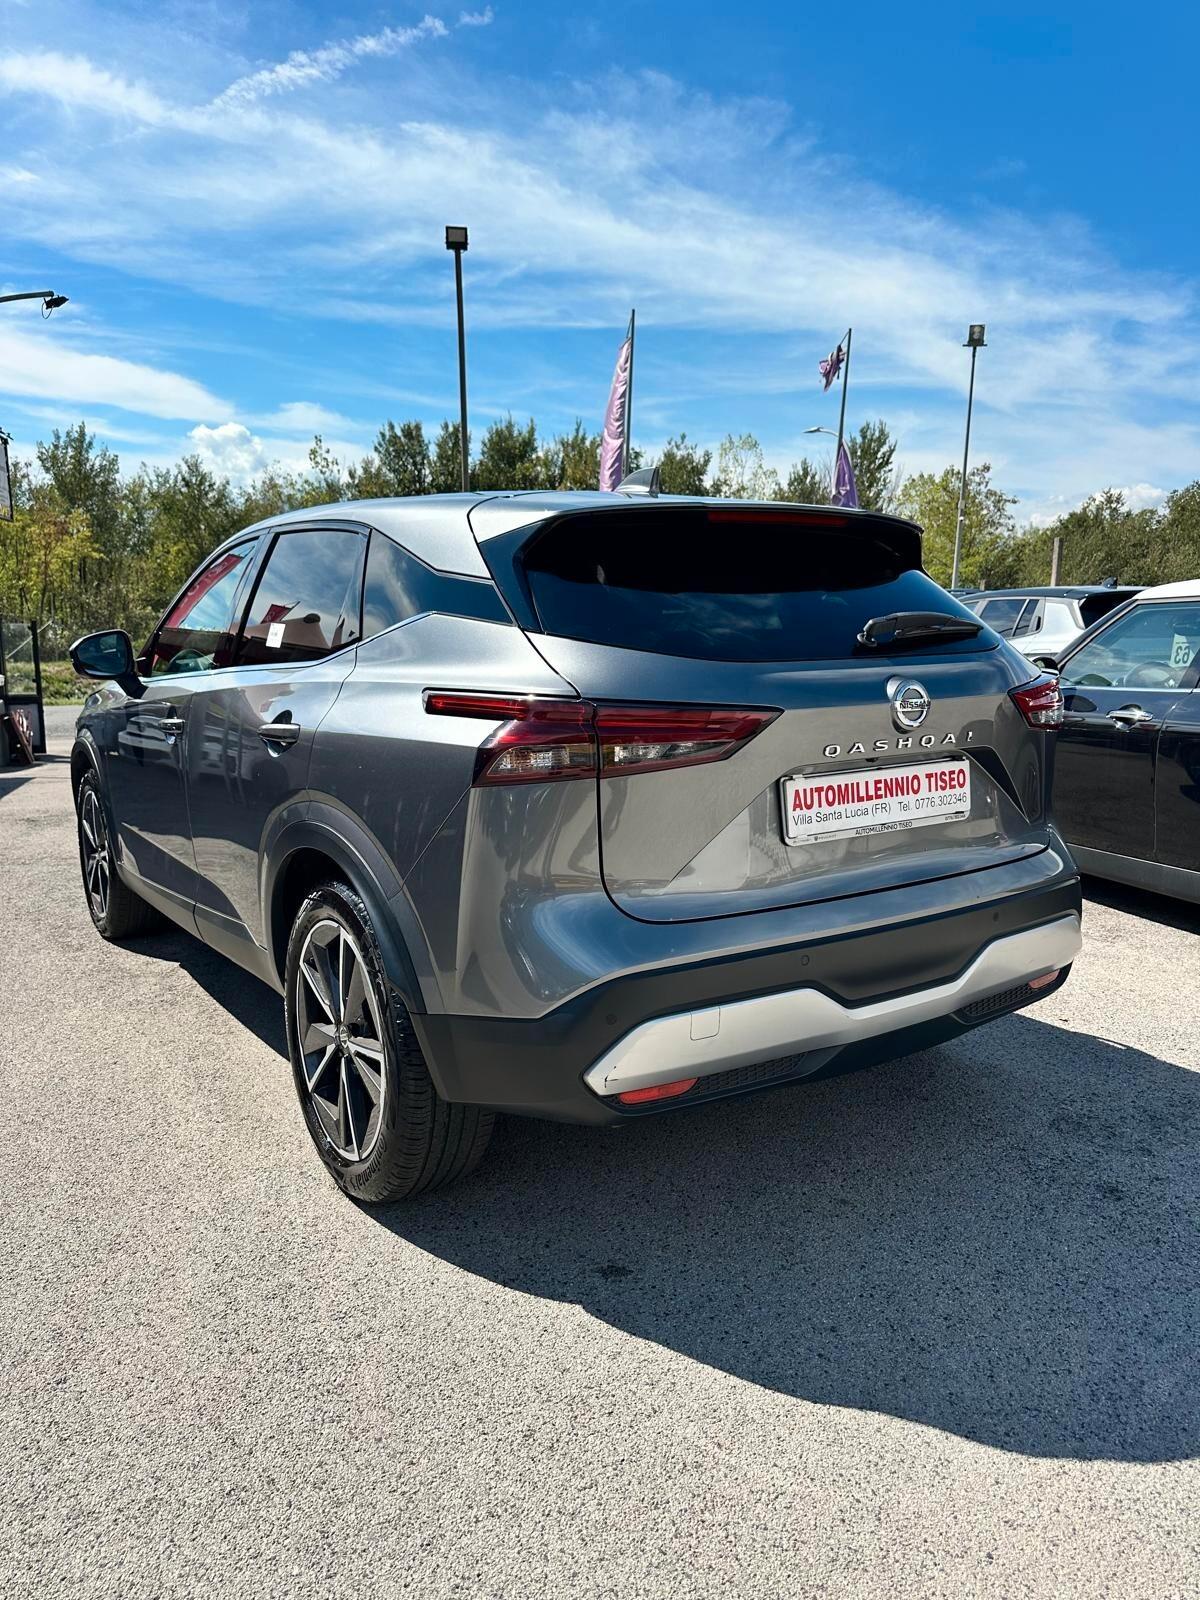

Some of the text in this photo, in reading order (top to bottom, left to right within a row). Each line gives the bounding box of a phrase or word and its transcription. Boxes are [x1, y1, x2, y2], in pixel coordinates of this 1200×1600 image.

[899, 700, 930, 710] NISSAN
[823, 731, 973, 757] QASHQAI
[792, 768, 966, 812] AUTOMILLENNIO TISEO
[792, 792, 967, 826] Villa Santa Lucia (FR) Tel. 0776.302346
[855, 820, 913, 836] AUTOMILLENNIO TISEO
